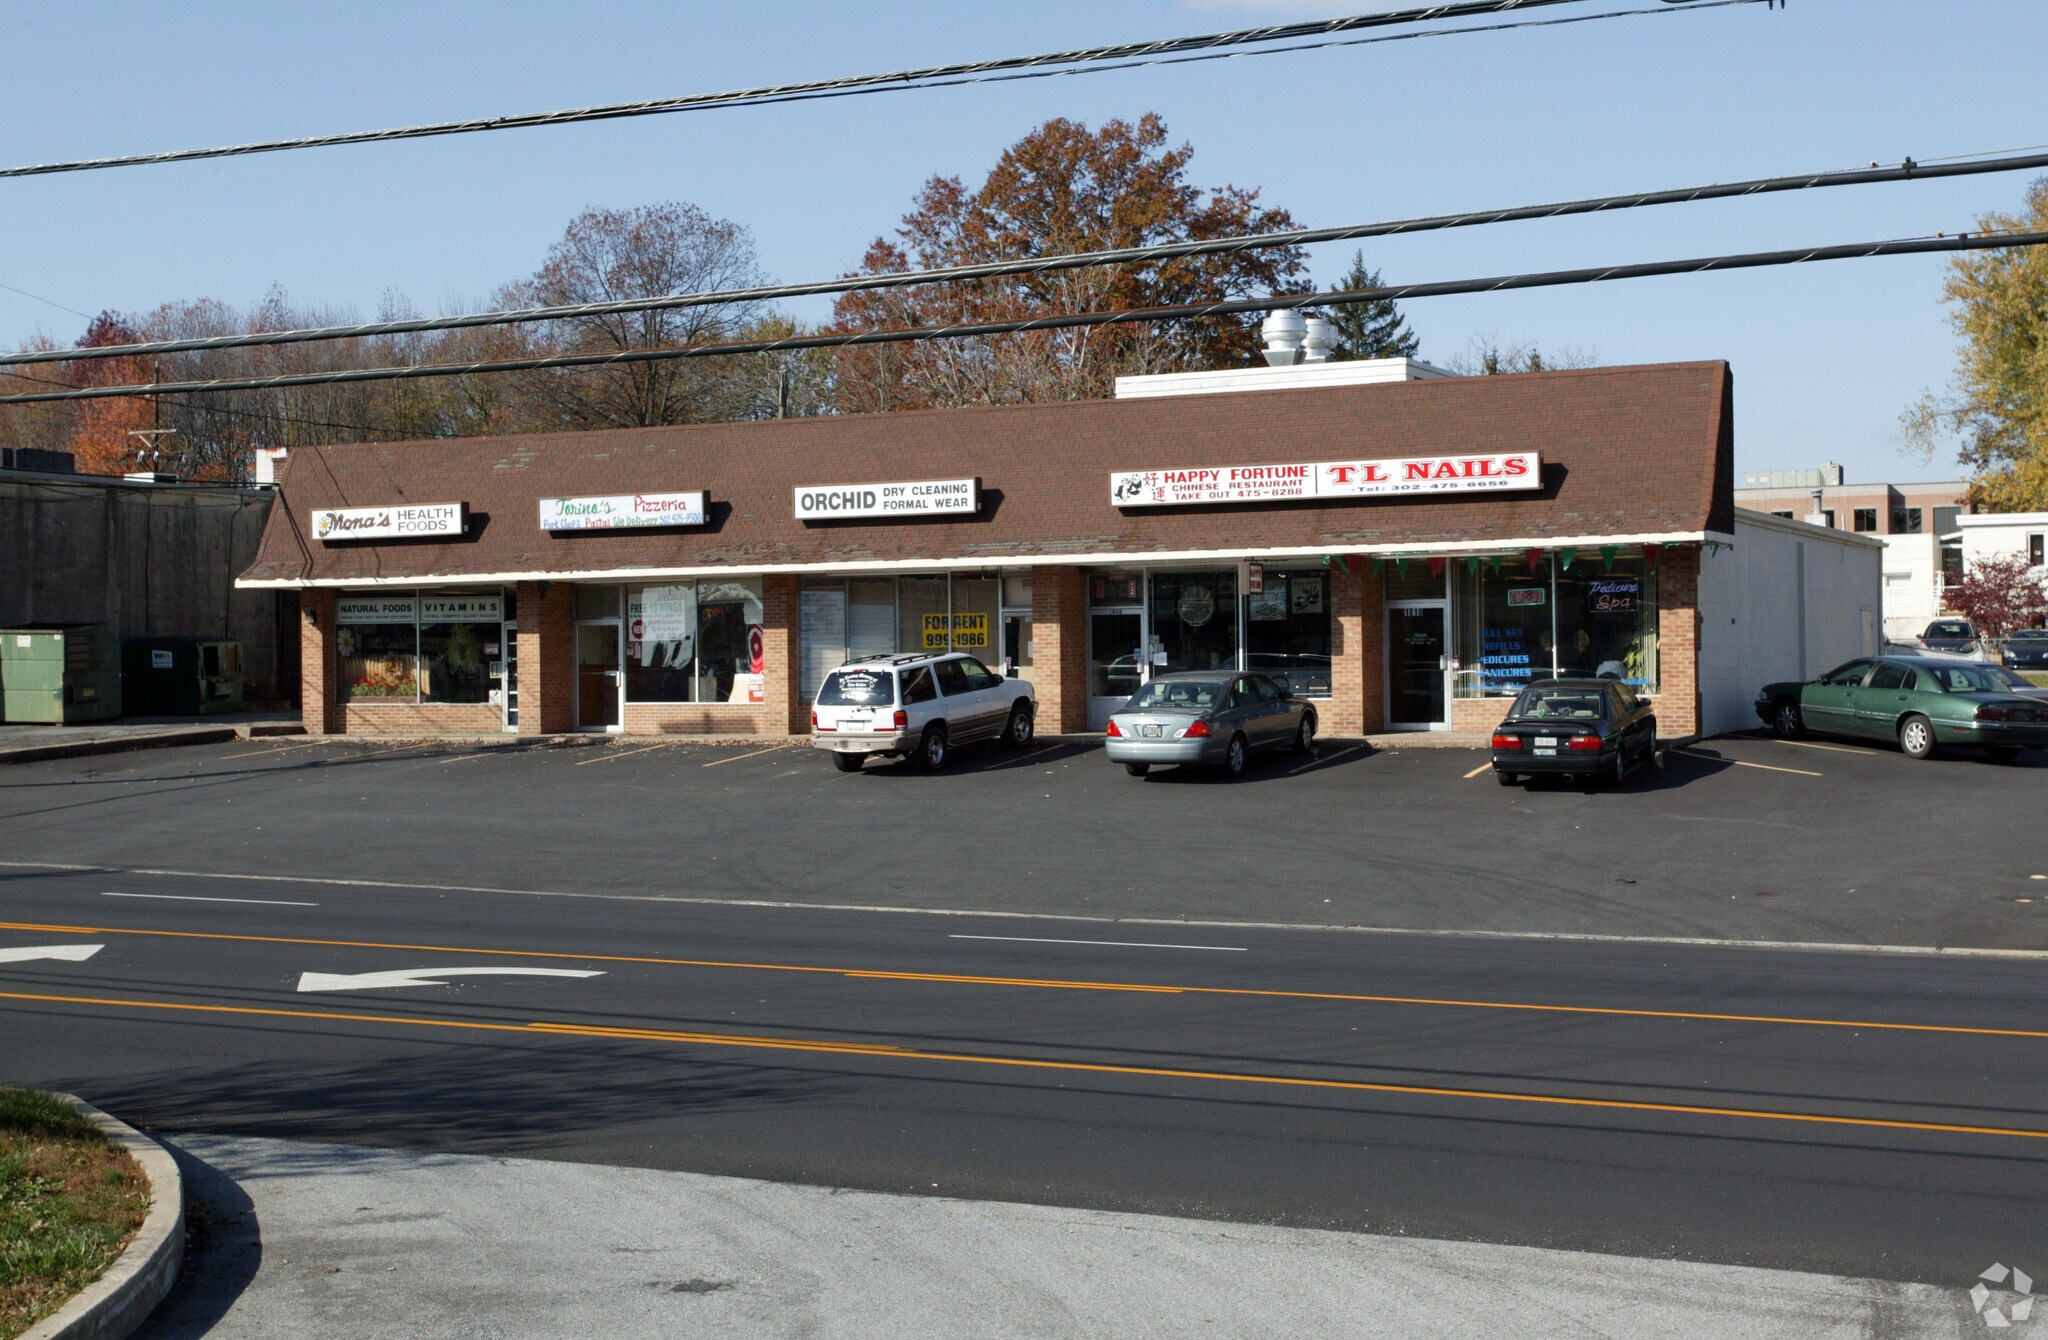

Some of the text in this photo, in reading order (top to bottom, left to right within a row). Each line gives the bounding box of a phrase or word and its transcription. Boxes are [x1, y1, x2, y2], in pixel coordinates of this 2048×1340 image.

[1164, 466, 1309, 484] HAPPY FORTUNE
[1327, 456, 1529, 485] TL NAILS
[883, 484, 968, 496] DRY CLEANING
[1172, 479, 1303, 492] CHINESE RESTAURANT
[1391, 480, 1509, 491] 302-475-6656
[1175, 488, 1302, 501] TAKE OUT 475-8288
[634, 495, 687, 513] Pizzeria
[801, 491, 877, 512] ORCHID
[883, 498, 968, 510] FORMAL WEAR
[397, 508, 453, 520] HEALTH
[319, 512, 392, 537] Mona's
[397, 520, 447, 532] FOODS
[1589, 581, 1638, 595] Pedicure
[340, 604, 412, 613] NATURAL FOODS
[425, 603, 497, 611] VITAMINS
[630, 602, 683, 613] FREE 10 WINGS
[1596, 595, 1630, 611] Spa
[924, 615, 985, 630] FOR RENT
[1480, 628, 1502, 637] ULL
